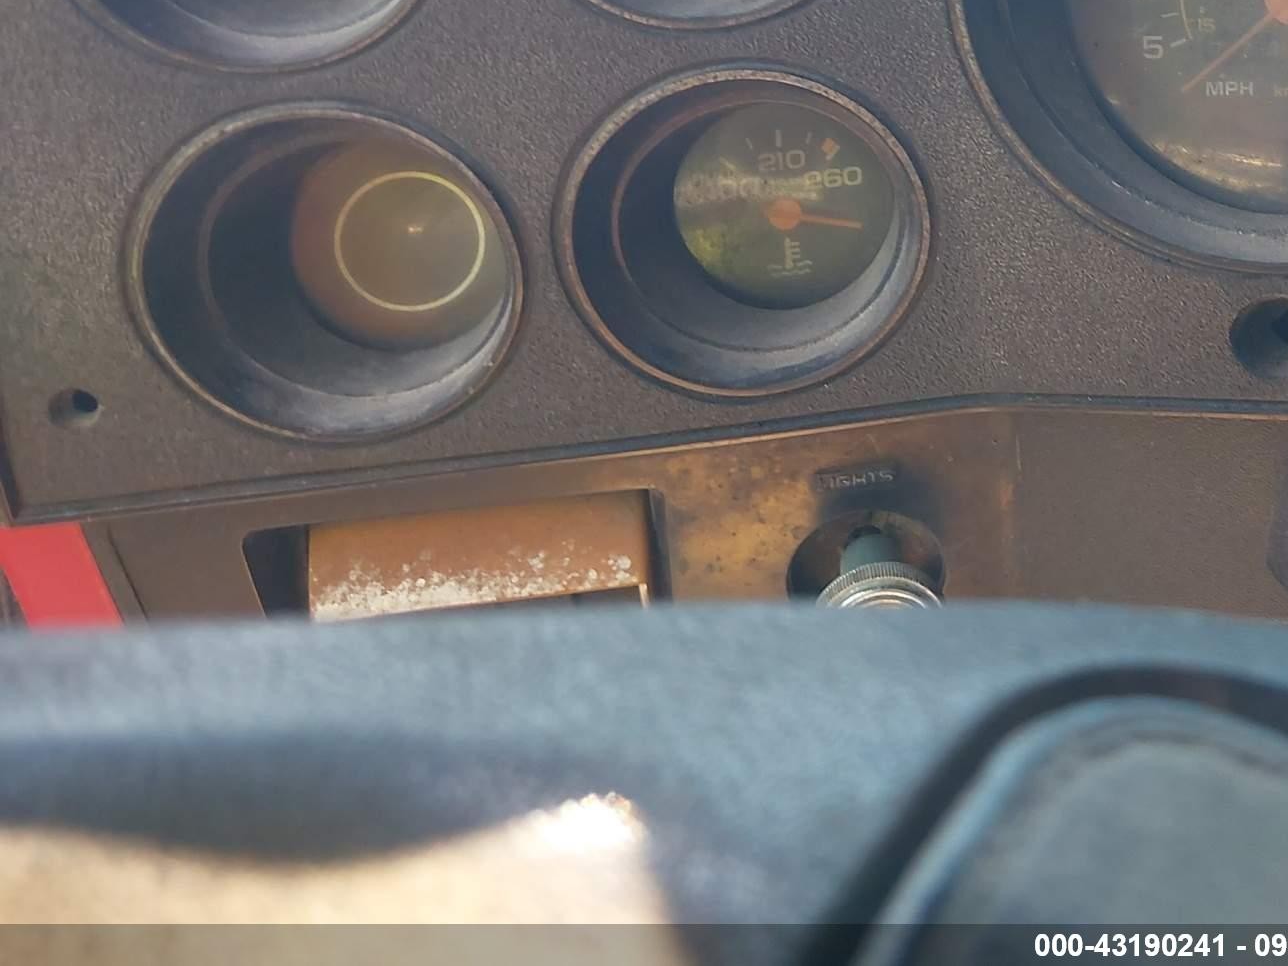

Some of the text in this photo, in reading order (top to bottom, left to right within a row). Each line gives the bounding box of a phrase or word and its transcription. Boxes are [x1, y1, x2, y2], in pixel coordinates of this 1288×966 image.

[1143, 36, 1163, 59] 5
[1205, 81, 1255, 97] MPH
[757, 149, 806, 172] 210
[804, 166, 862, 190] 260
